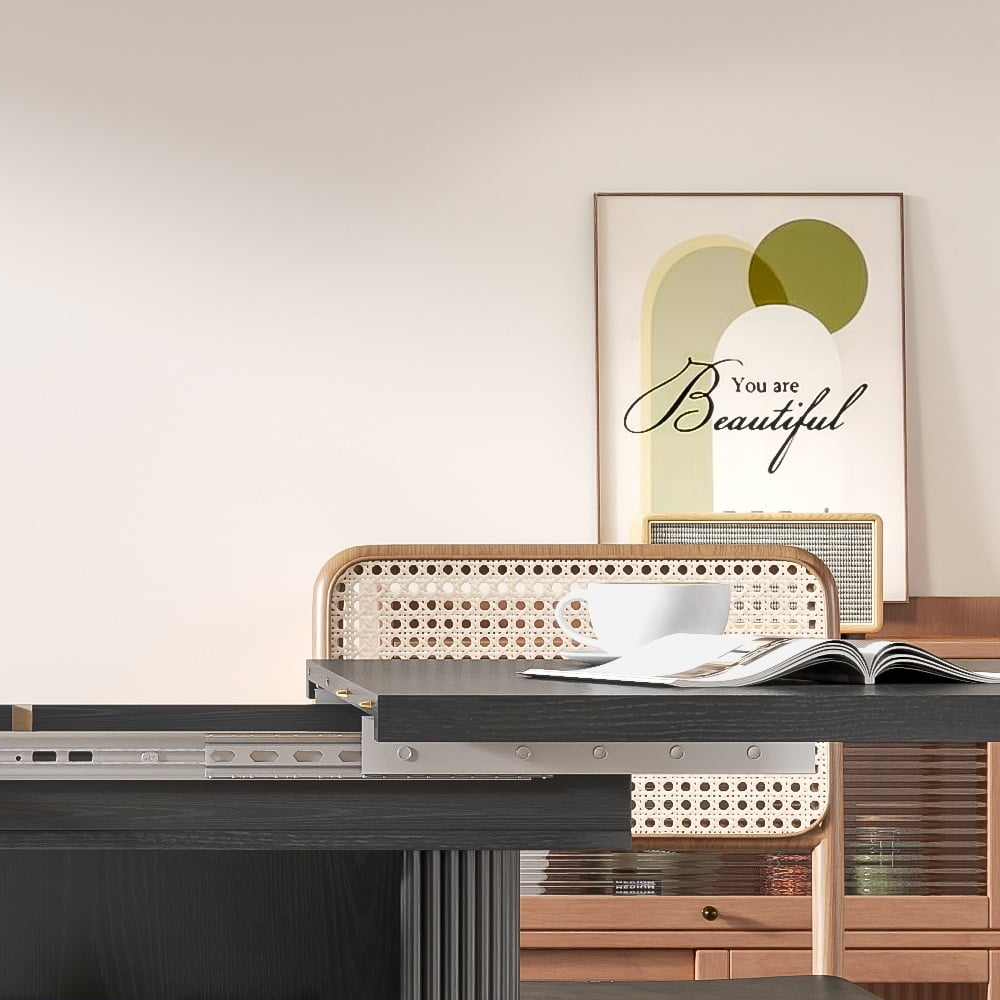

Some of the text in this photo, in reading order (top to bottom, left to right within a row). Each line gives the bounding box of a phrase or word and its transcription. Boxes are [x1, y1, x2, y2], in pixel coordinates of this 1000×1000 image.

[623, 357, 868, 474] Beautiful
[731, 376, 800, 394] You are
